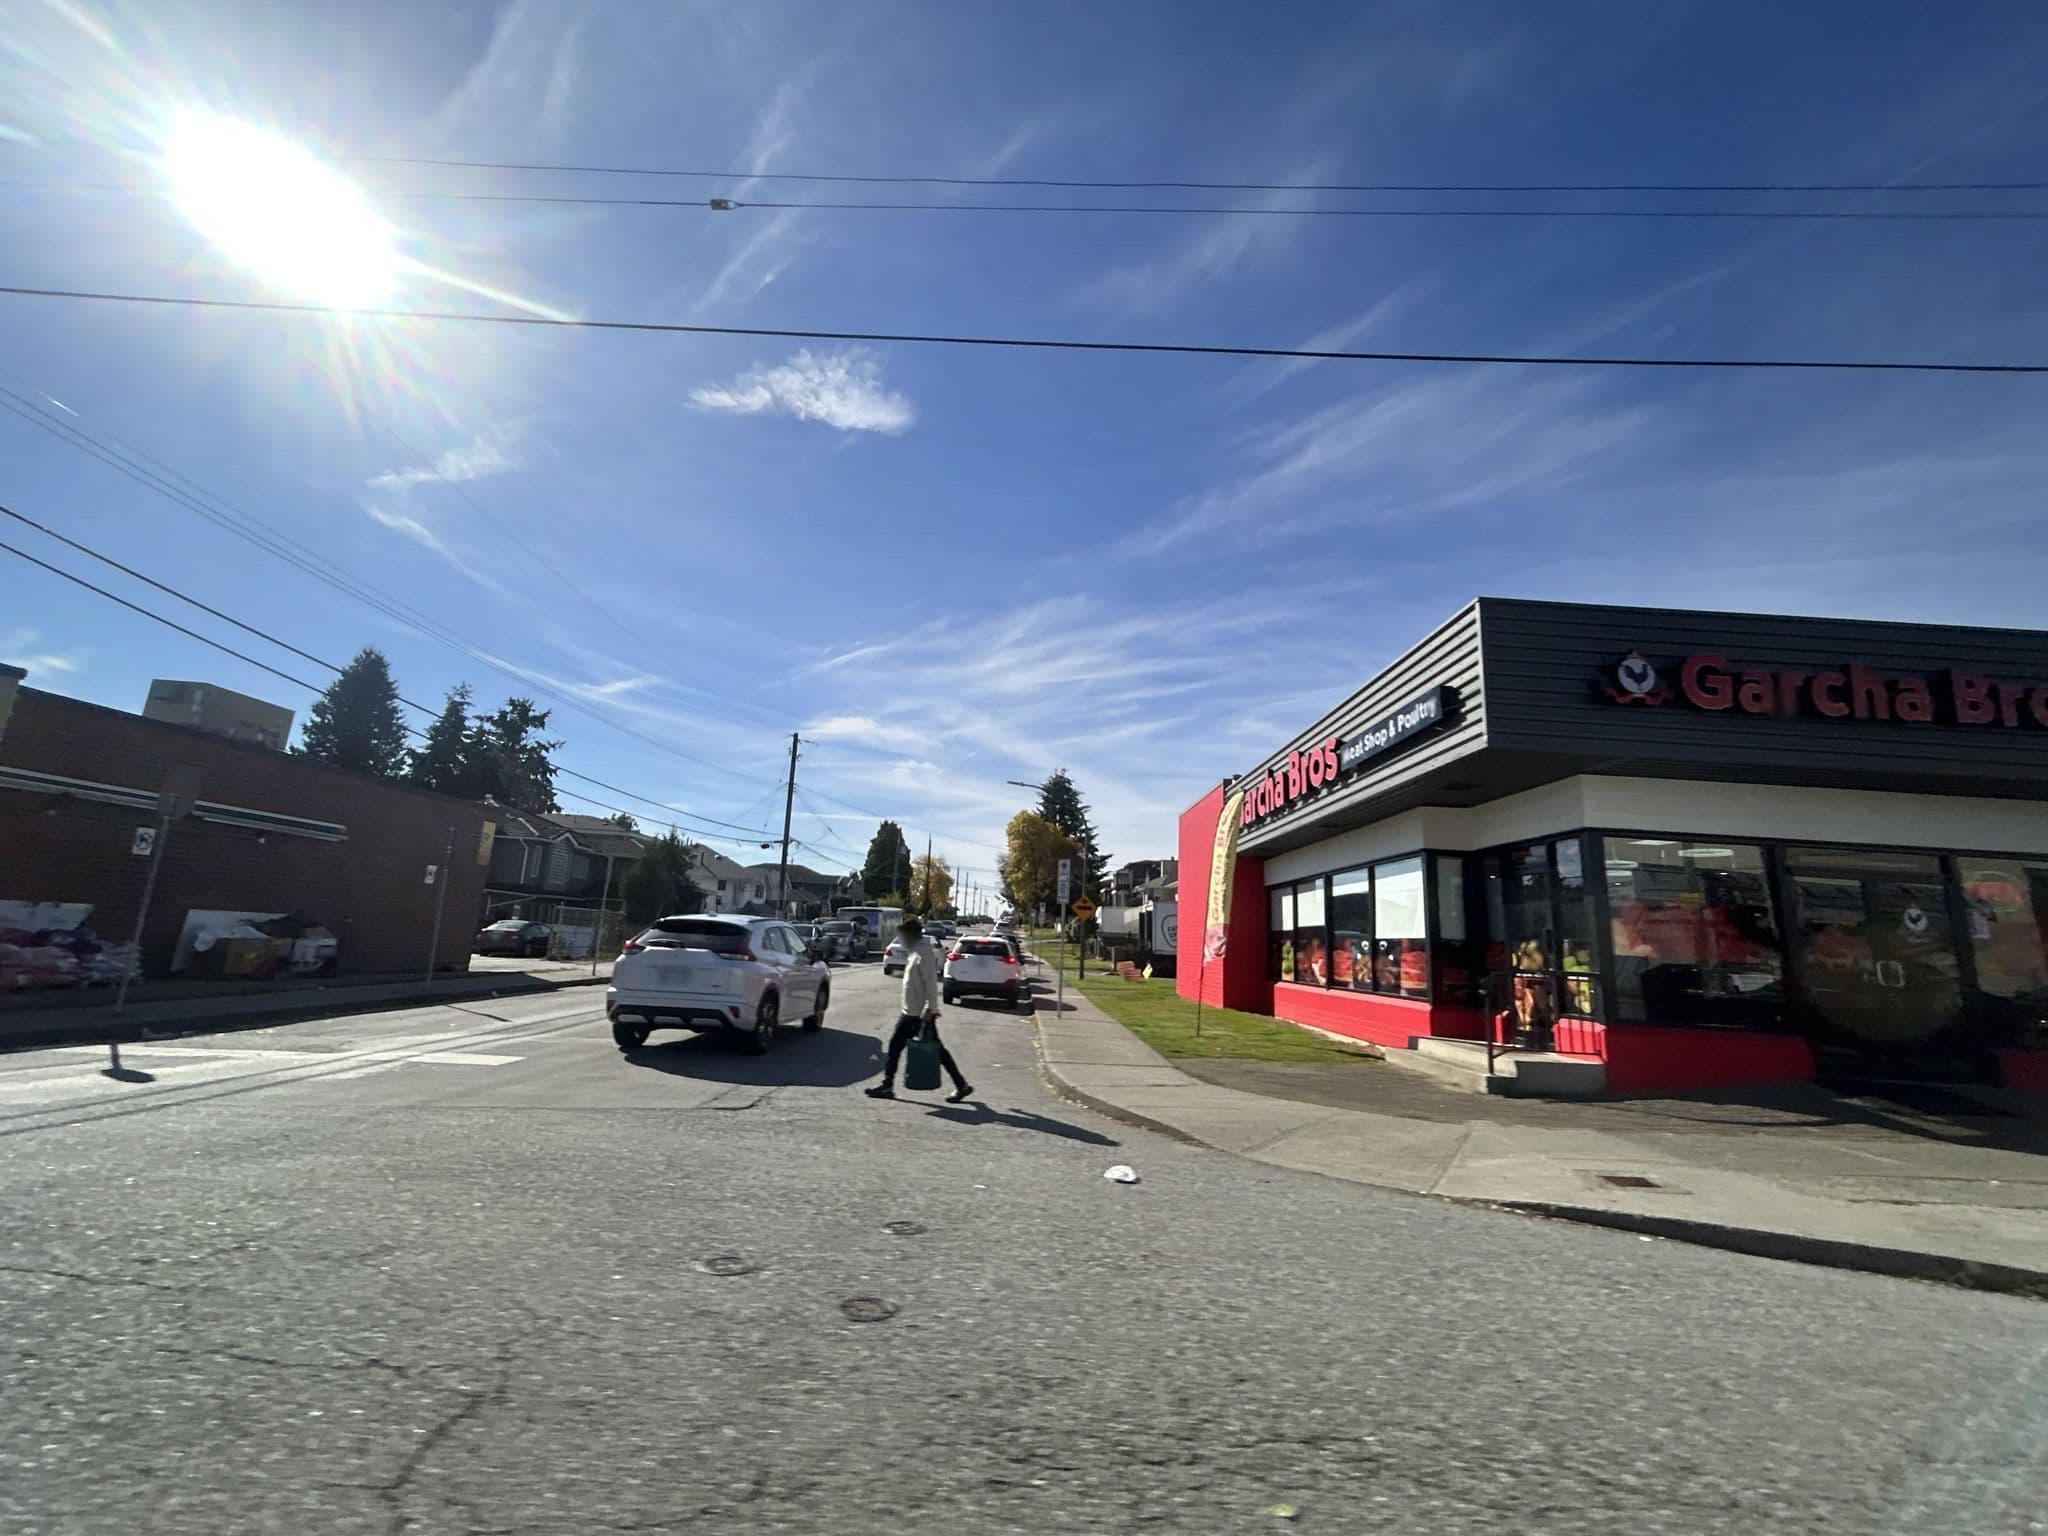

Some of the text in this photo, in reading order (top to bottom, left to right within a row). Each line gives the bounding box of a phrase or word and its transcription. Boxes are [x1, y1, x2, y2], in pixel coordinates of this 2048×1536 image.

[1681, 653, 1936, 722] Garcha
[1364, 728, 1388, 752] Shop
[1388, 719, 1396, 738] &
[1240, 737, 1338, 827] archa Bros
